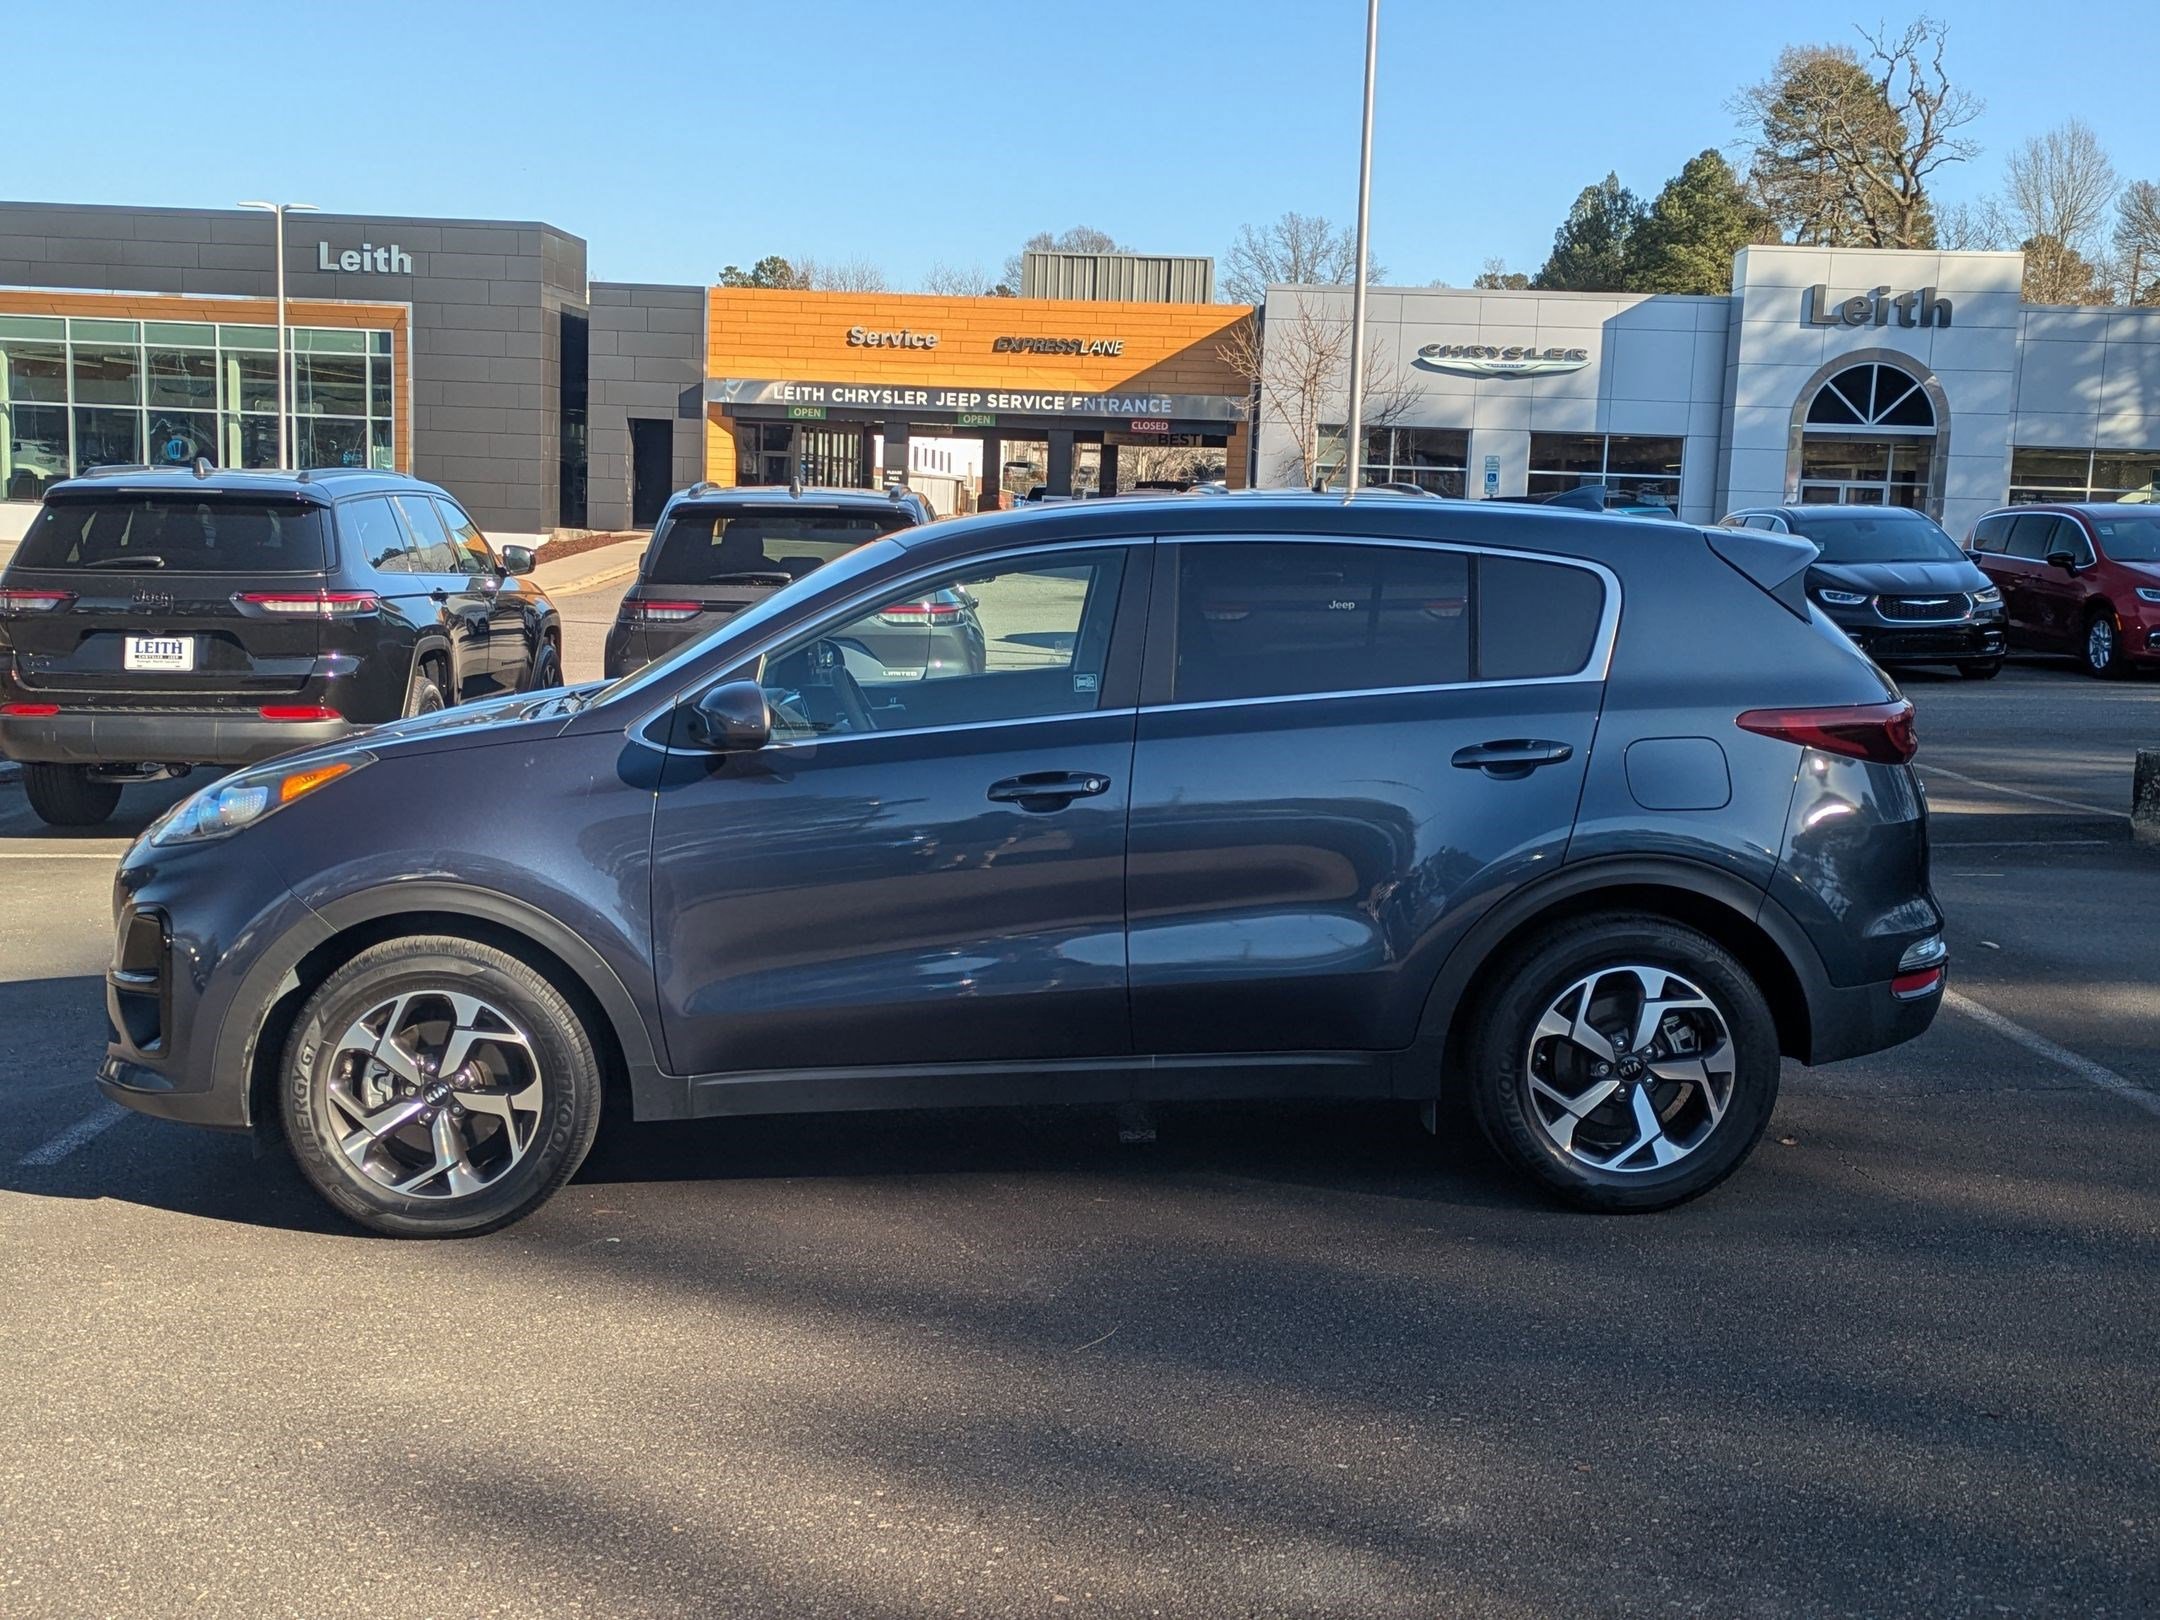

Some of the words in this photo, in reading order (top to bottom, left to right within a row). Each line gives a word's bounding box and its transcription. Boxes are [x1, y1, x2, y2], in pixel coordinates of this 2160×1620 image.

[319, 241, 412, 273] Leith
[1810, 284, 1953, 328] Leith
[849, 325, 938, 348] Service
[1421, 343, 1588, 361] CHRYSLER
[773, 385, 825, 402] LEITH
[832, 388, 928, 405] CHRYSLER
[935, 392, 981, 408] JEEP
[987, 393, 1065, 410] SERVICE
[1071, 396, 1172, 413] ENTRANCE
[793, 407, 822, 417] OPEN
[962, 414, 991, 424] OPEN
[1131, 421, 1169, 431] CLOSED
[1158, 433, 1201, 446] BEST
[1328, 600, 1356, 610] Jeep
[135, 641, 183, 654] LEITH
[1619, 1061, 1642, 1077] KIA
